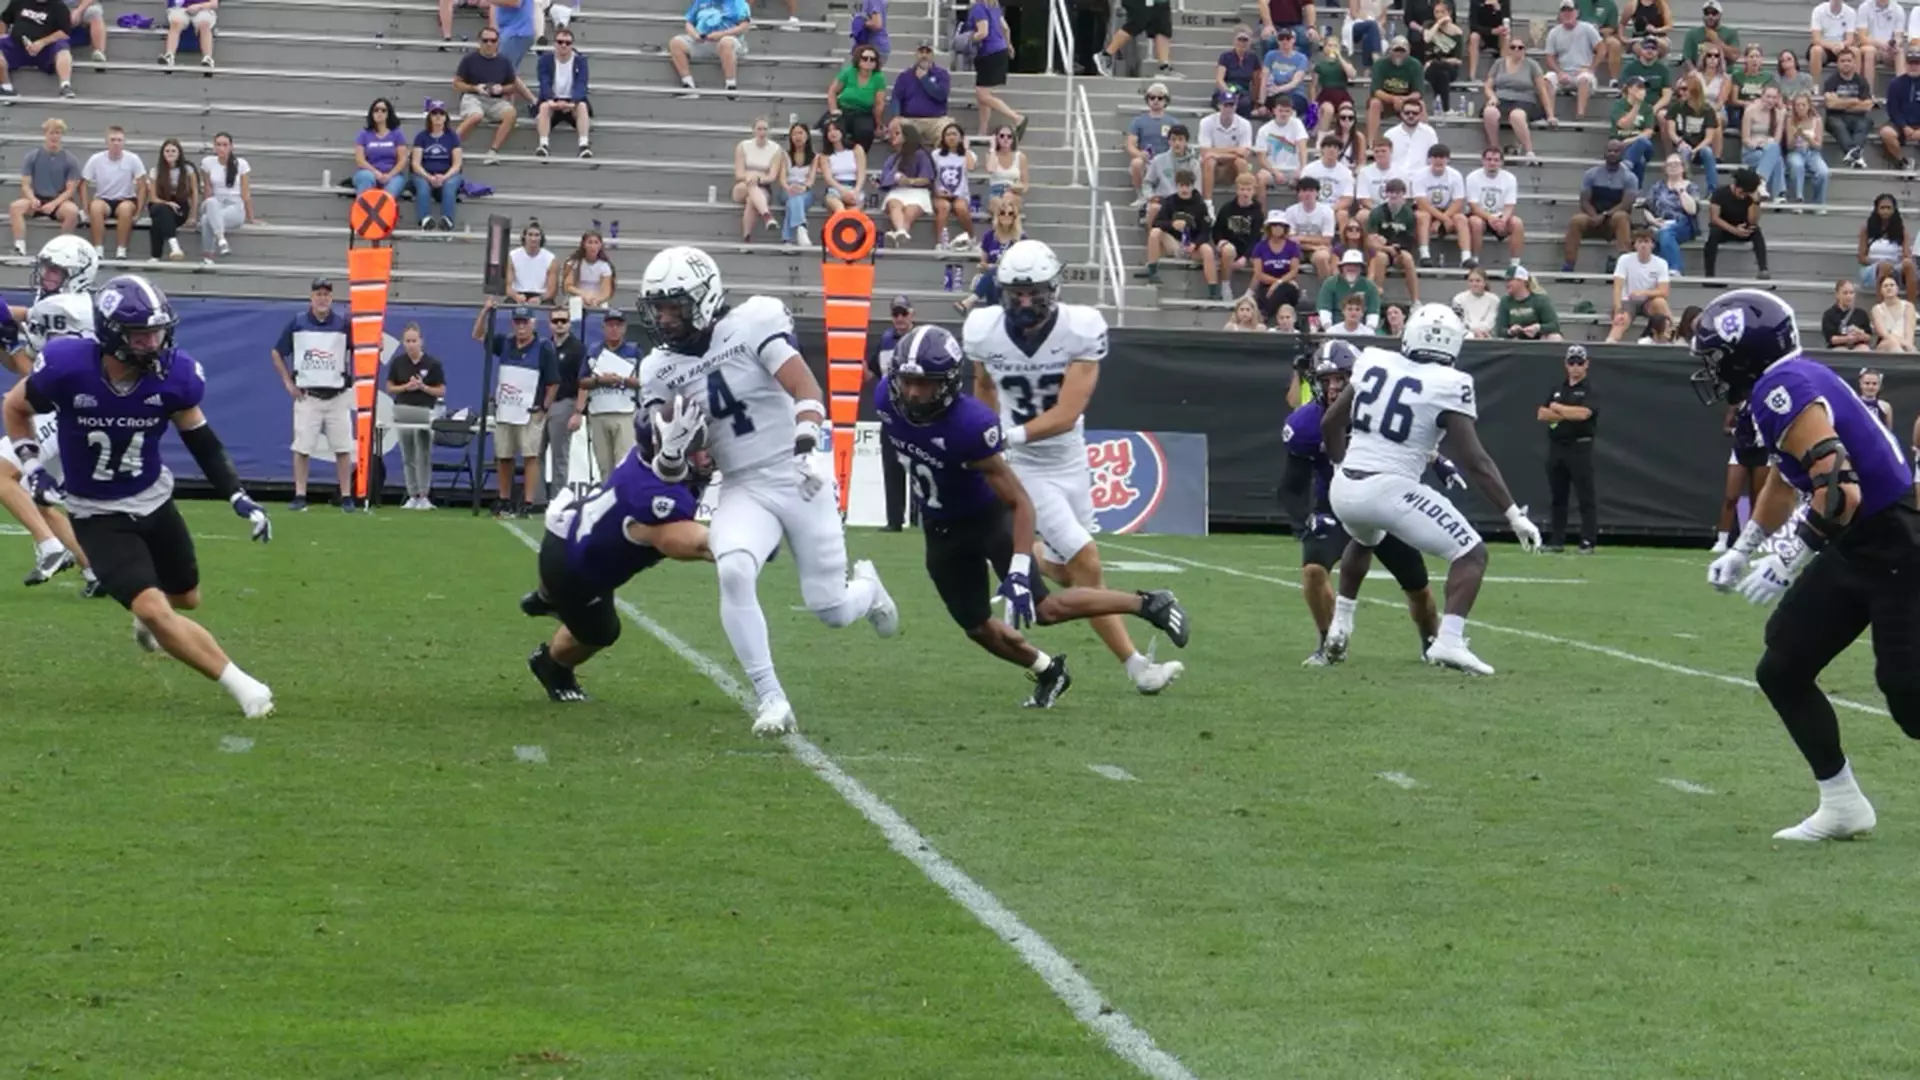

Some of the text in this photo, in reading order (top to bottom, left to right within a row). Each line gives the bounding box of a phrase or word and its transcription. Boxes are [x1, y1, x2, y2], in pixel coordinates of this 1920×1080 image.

[42, 314, 66, 331] 16
[77, 416, 114, 427] HOLY
[707, 369, 755, 438] 4
[1354, 366, 1423, 444] 26
[87, 431, 146, 480] 24
[1403, 492, 1473, 547] WILDCATS
